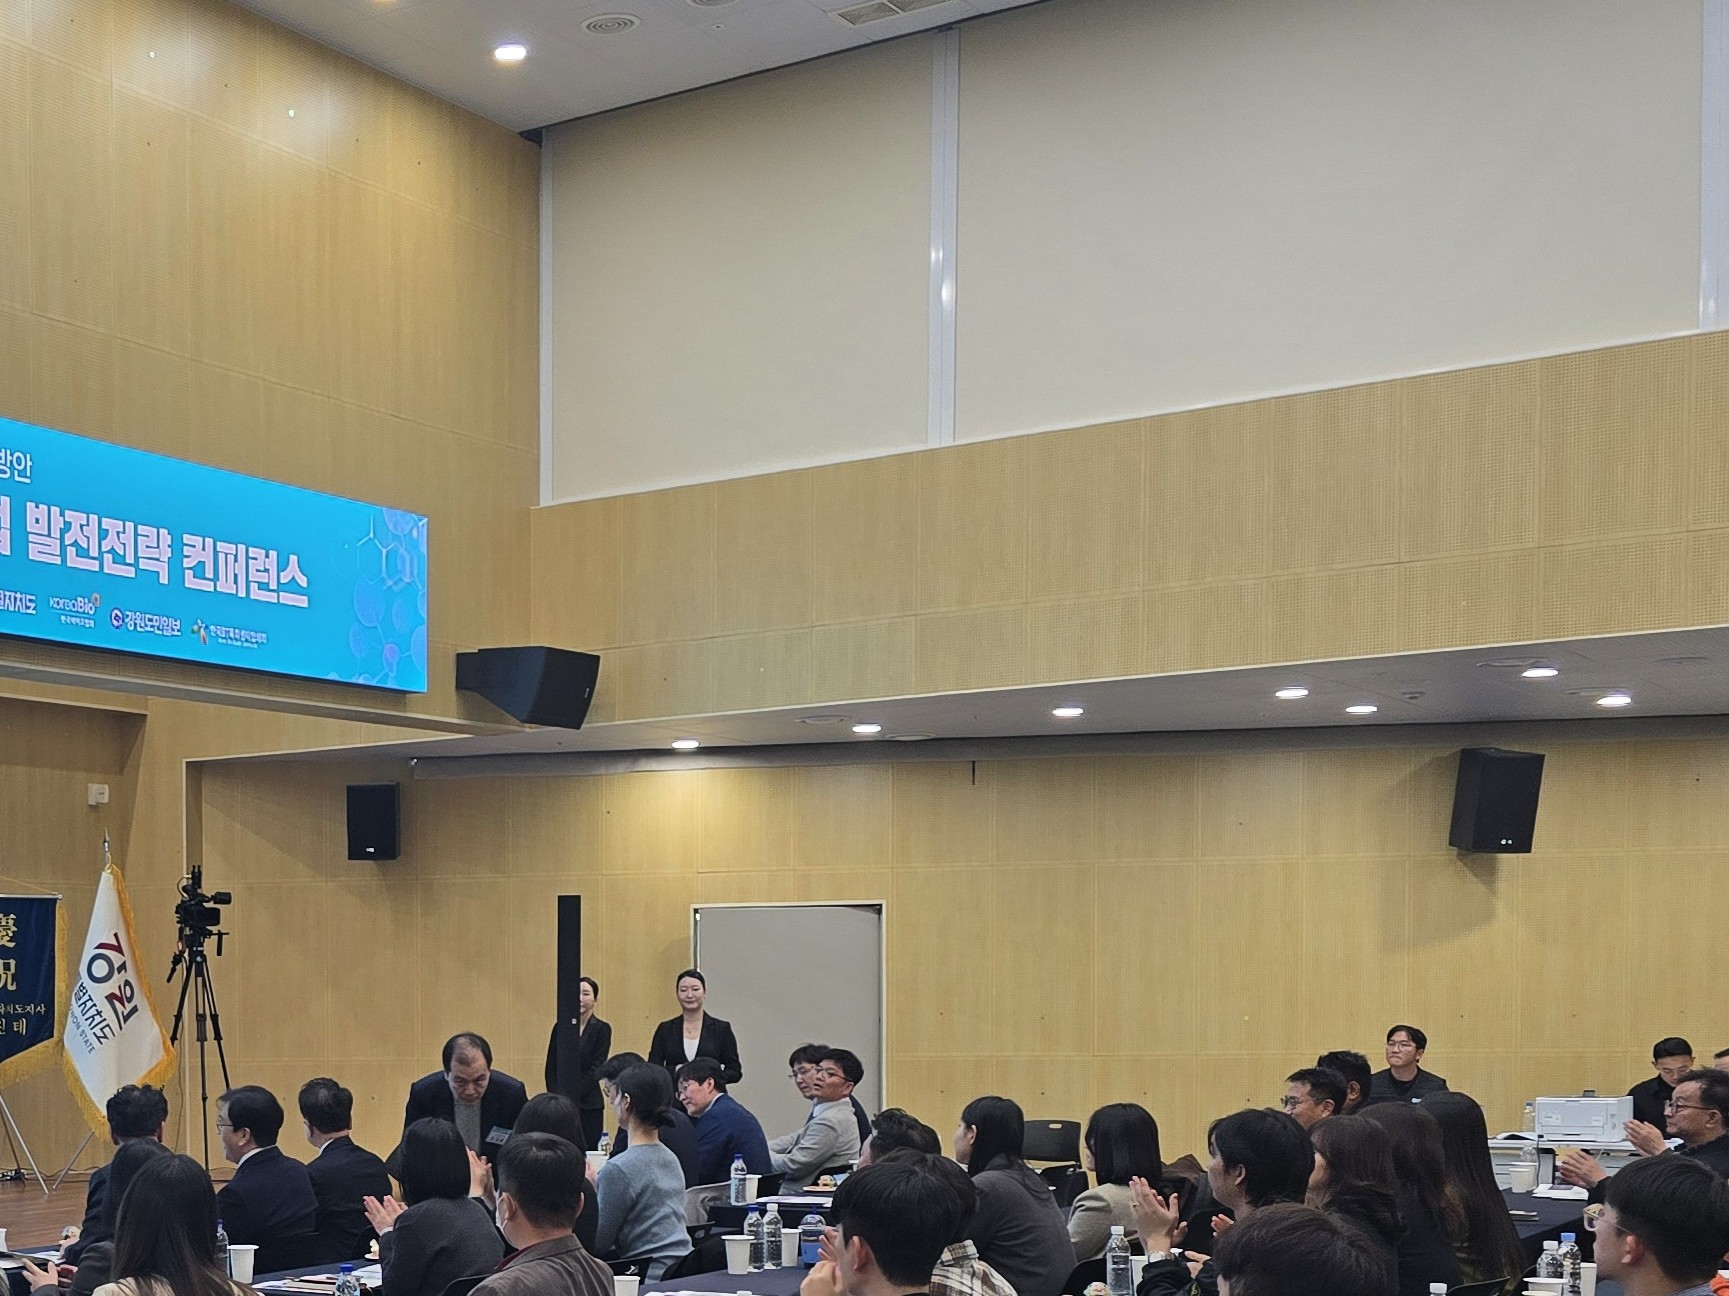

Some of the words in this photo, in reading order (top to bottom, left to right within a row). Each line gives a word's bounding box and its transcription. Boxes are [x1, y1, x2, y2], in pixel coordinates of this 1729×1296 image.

[25, 502, 173, 586] 발전전략
[181, 533, 310, 609] 컨퍼런스
[124, 609, 182, 637] 강원도민일보
[79, 1029, 96, 1055] STATE
